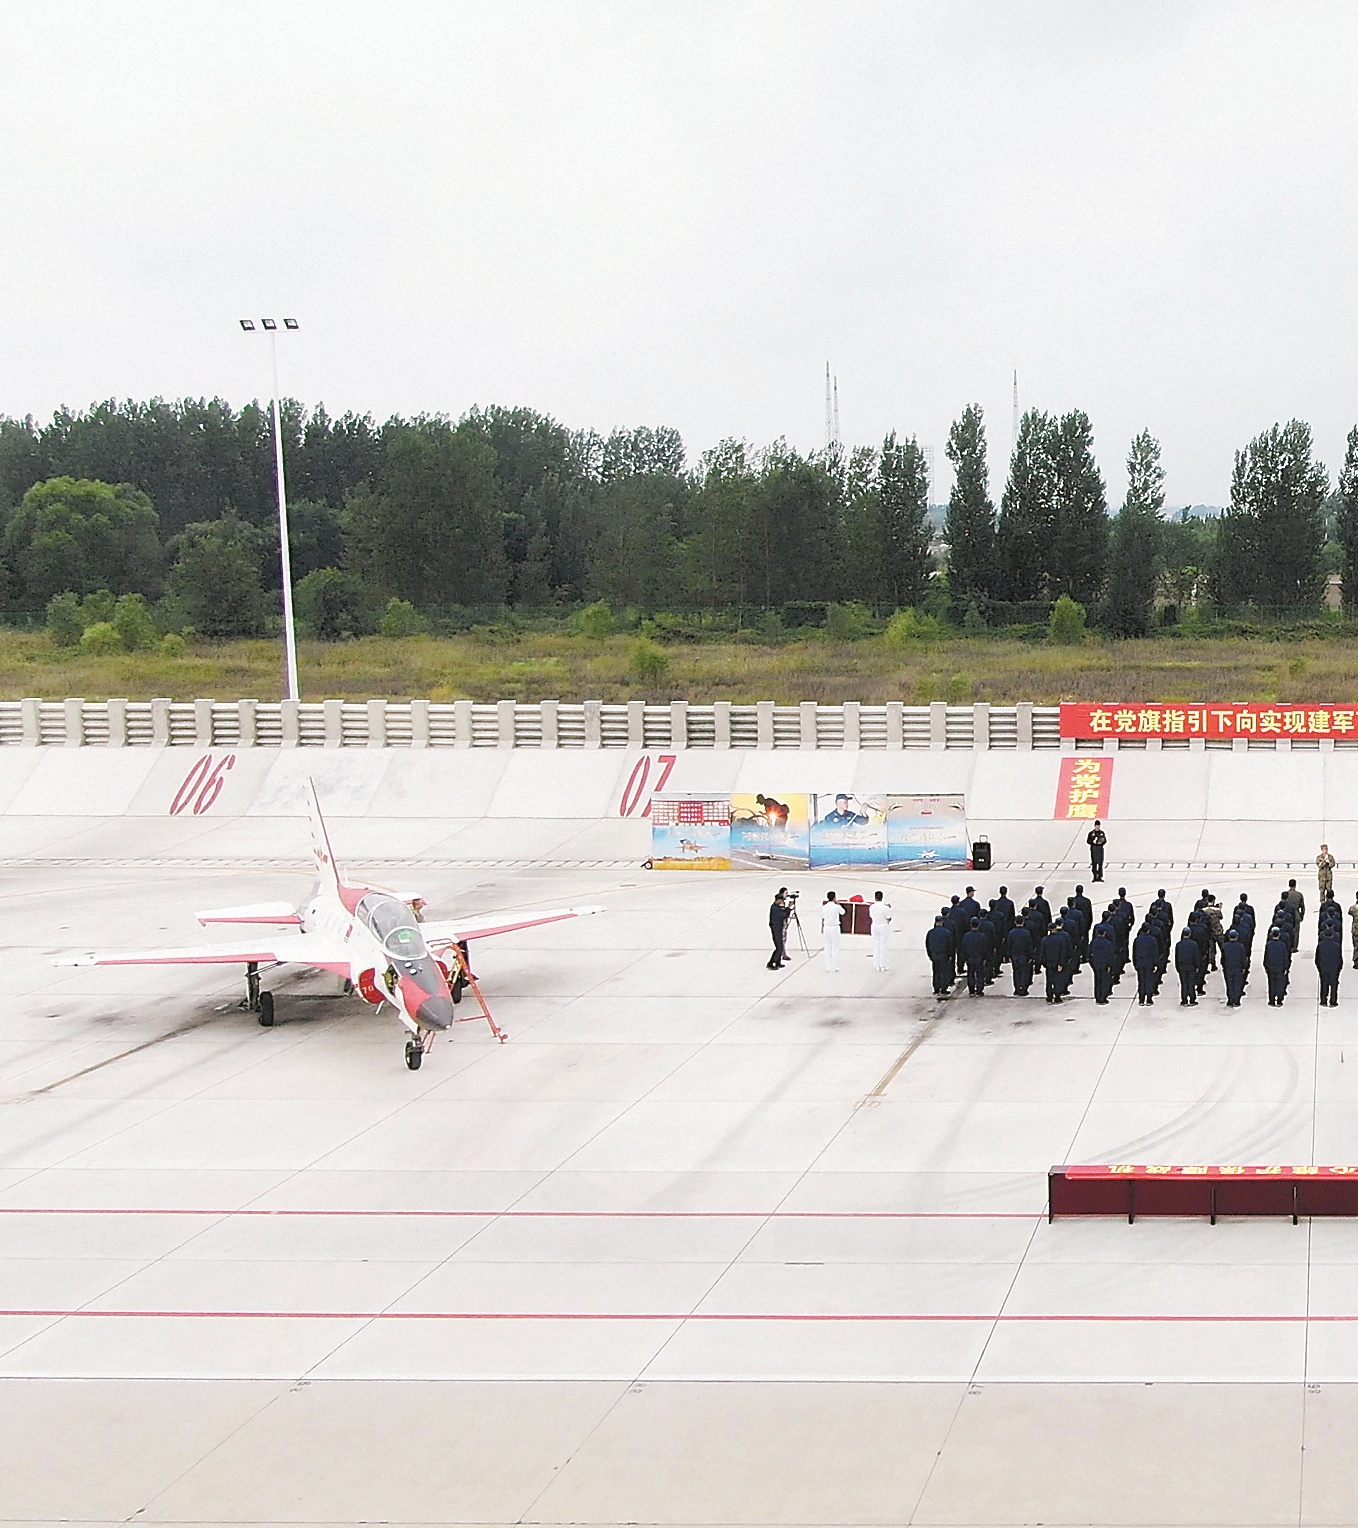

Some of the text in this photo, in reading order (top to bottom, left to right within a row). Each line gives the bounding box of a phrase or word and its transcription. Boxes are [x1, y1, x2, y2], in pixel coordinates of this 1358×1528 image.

[169, 754, 236, 816] 06
[619, 754, 677, 818] 07
[1065, 759, 1102, 819] 为党护鹰
